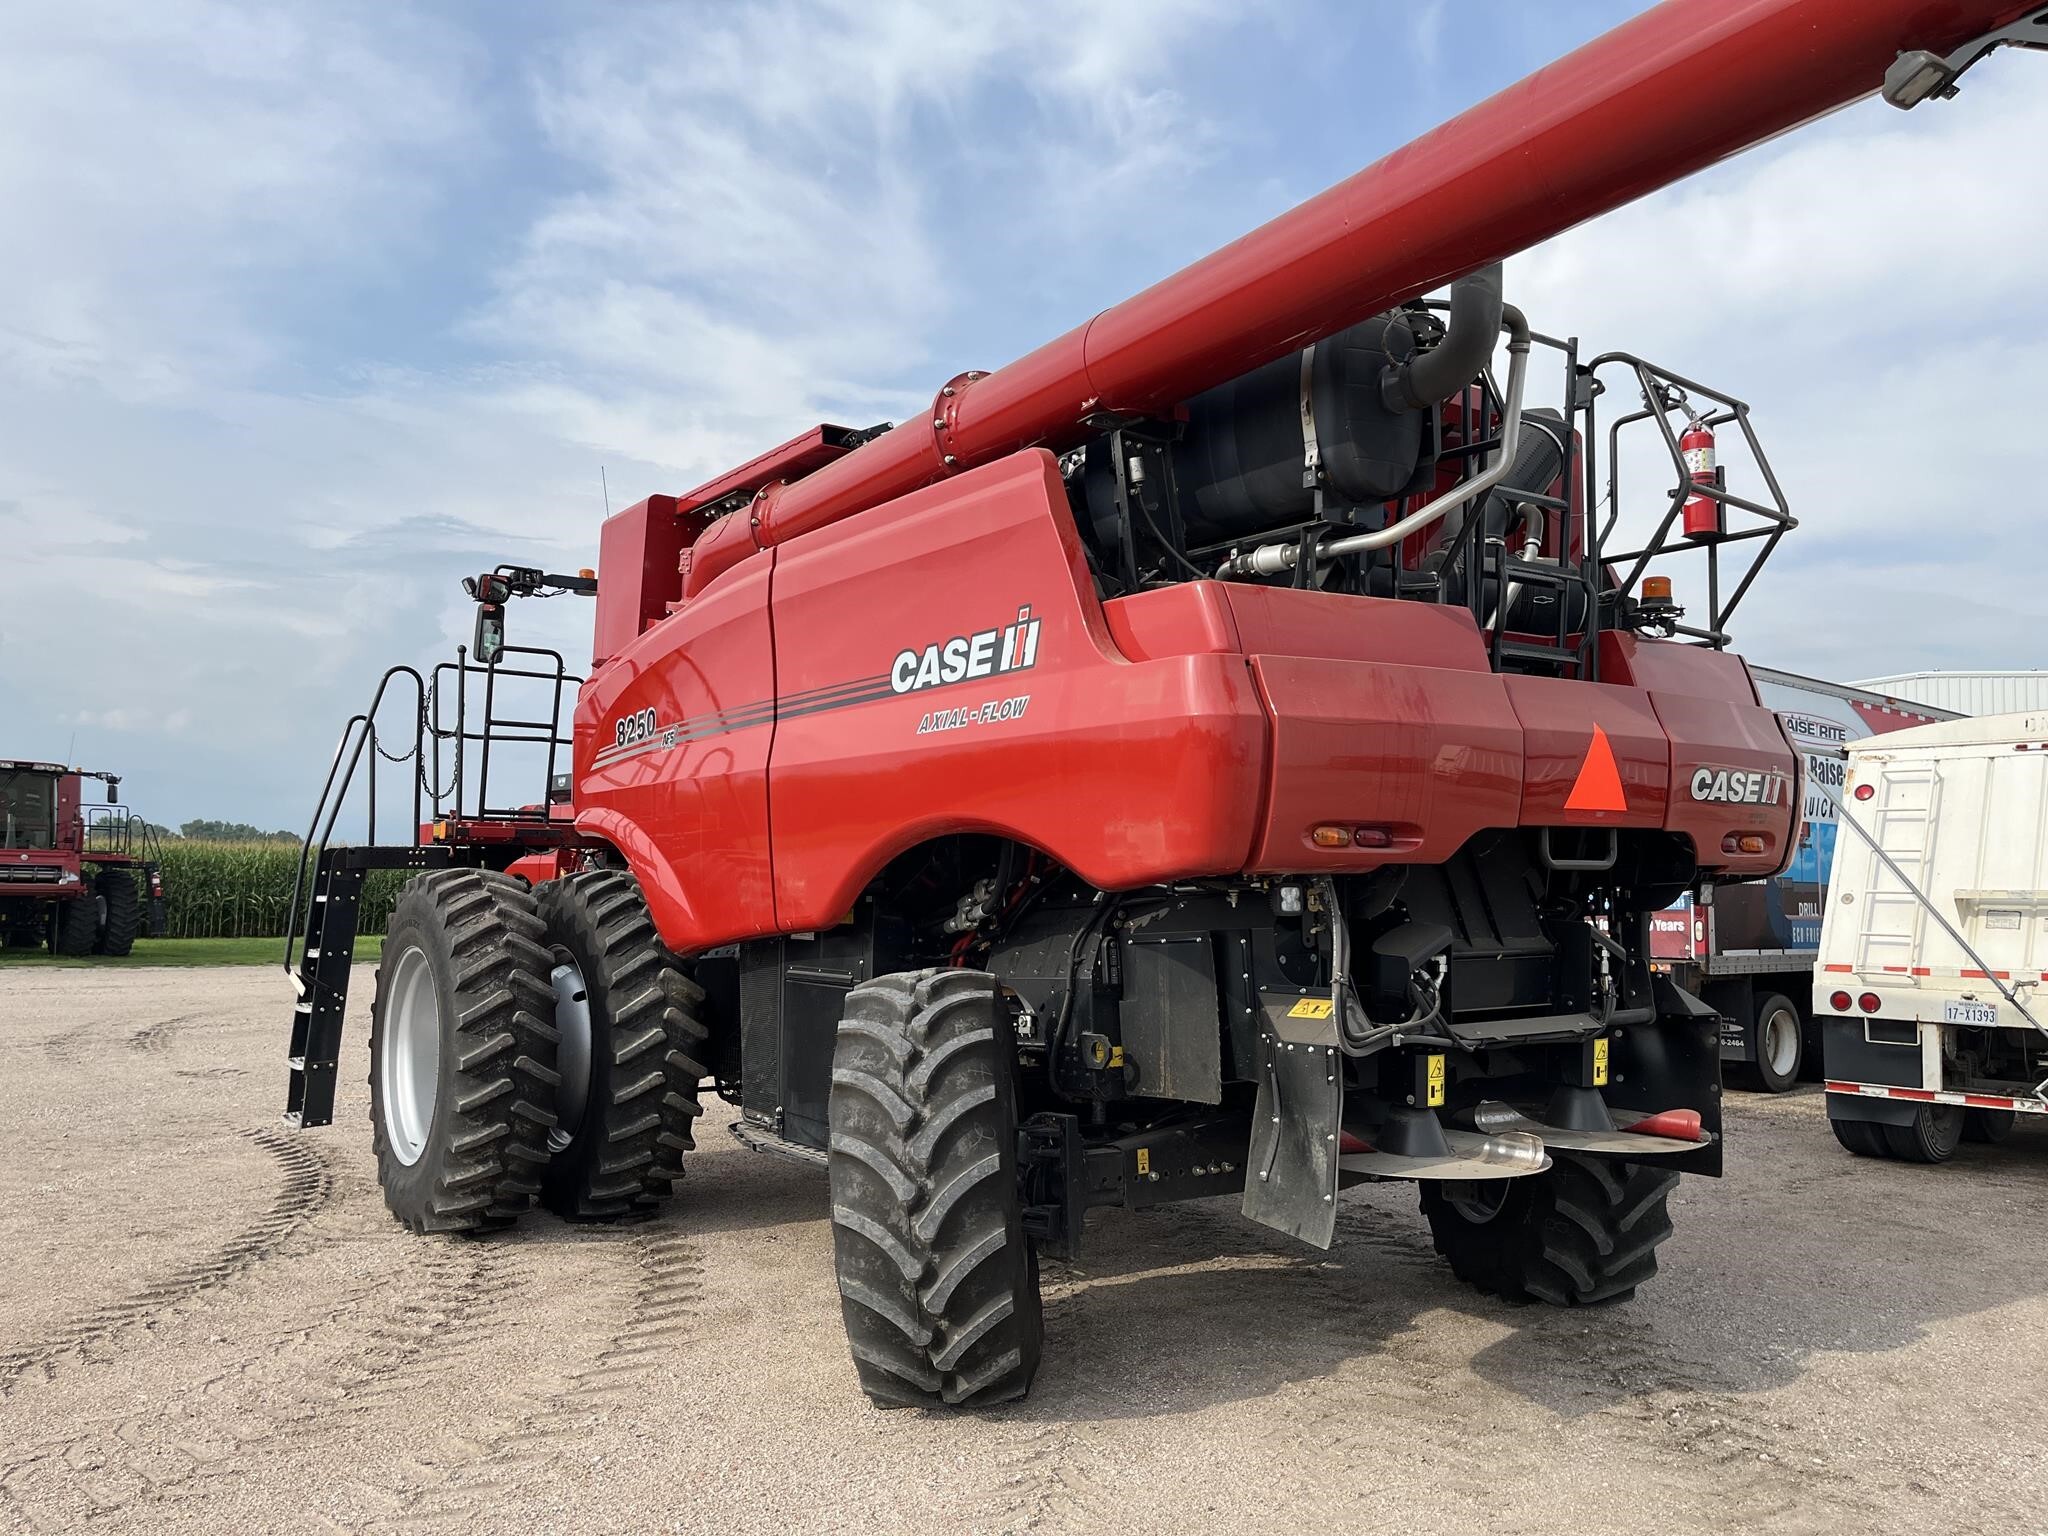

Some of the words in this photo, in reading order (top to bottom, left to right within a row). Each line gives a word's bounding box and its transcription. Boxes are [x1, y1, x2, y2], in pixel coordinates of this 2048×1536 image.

[890, 631, 997, 693] CASE
[917, 695, 1031, 735] AXIAL-FLOW
[615, 706, 656, 750] 8250
[1786, 718, 1815, 736] AISE
[1819, 725, 1846, 741] RITE
[1690, 768, 1761, 802] CASE
[1804, 796, 1835, 819] UICK
[1798, 902, 1819, 917] DRILL
[1655, 919, 1685, 932] Years
[1948, 1007, 1995, 1023] 17-X1393
